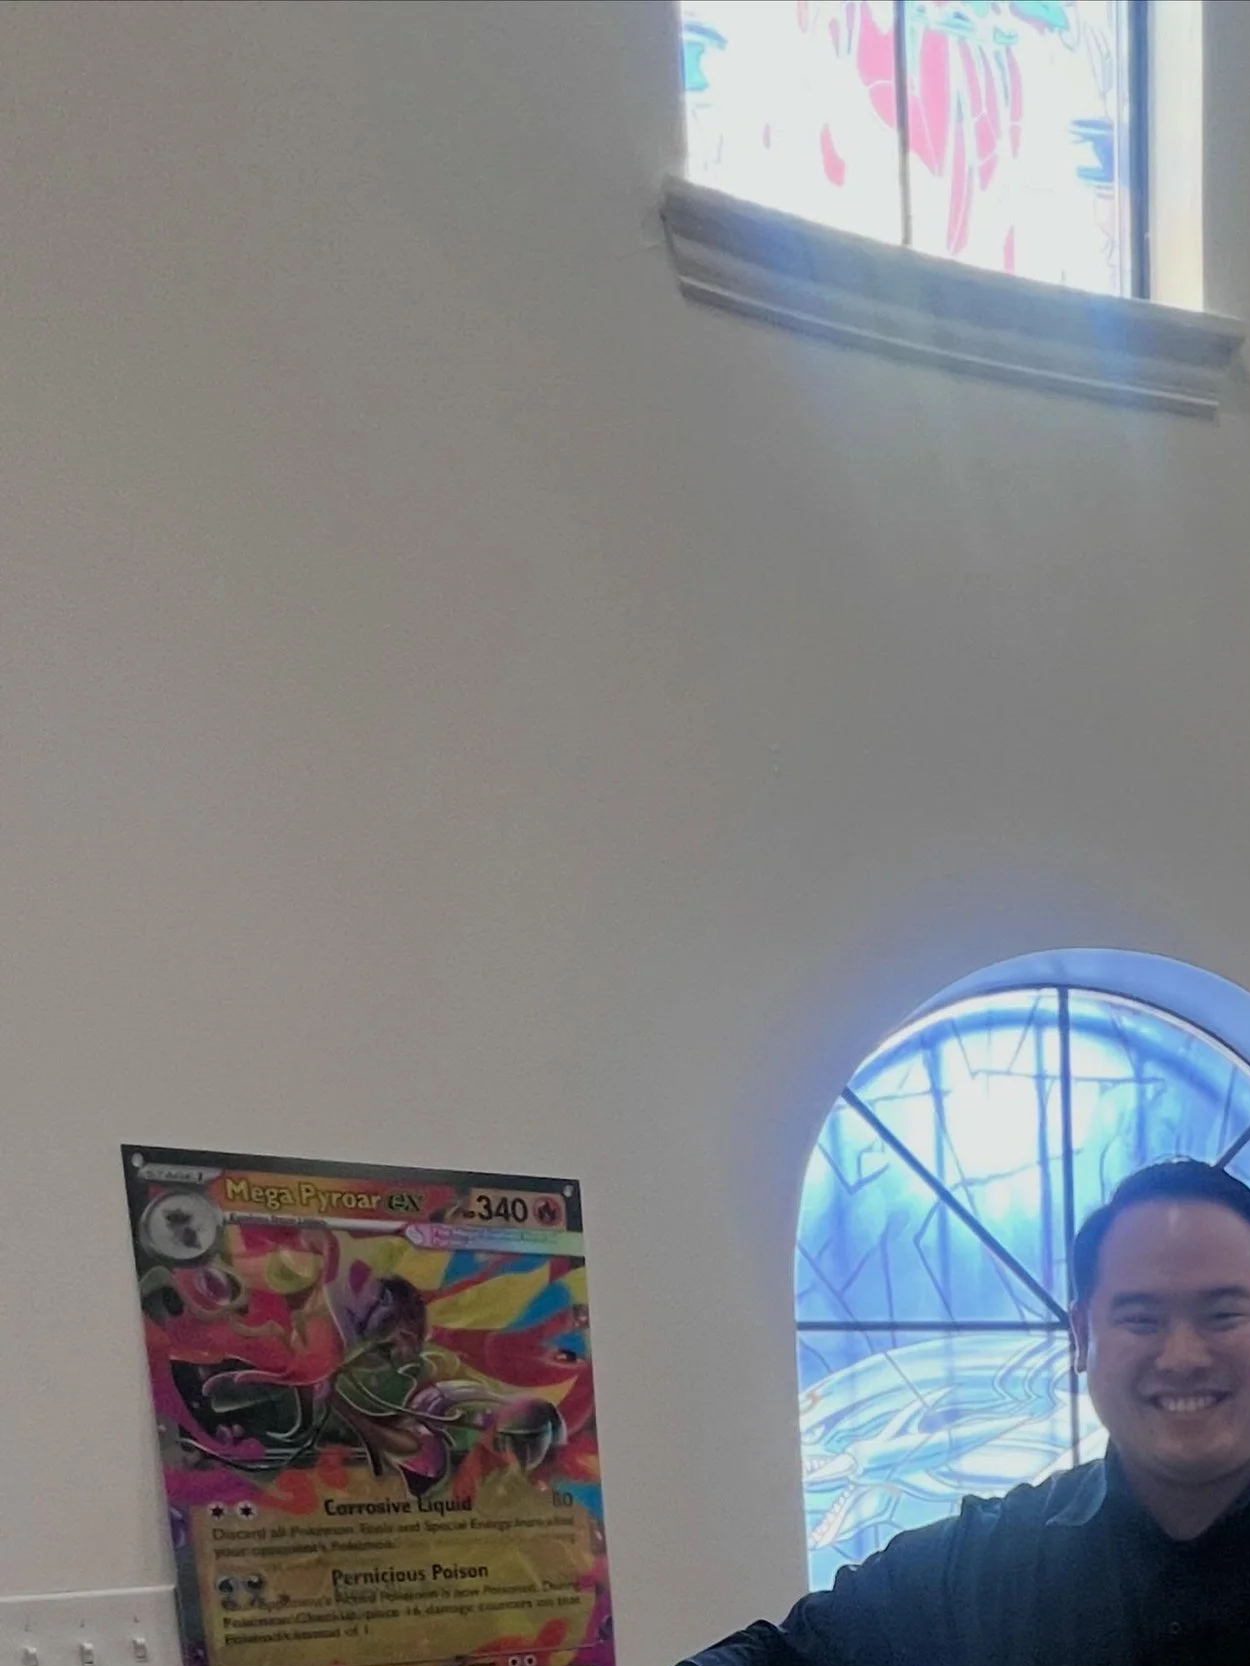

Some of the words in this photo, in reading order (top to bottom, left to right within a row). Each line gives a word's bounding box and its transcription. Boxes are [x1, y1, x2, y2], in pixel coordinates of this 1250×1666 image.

[225, 1178, 294, 1211] Mega
[299, 1182, 381, 1213] Pyroar
[387, 1193, 426, 1212] ex
[476, 1195, 529, 1223] 340
[324, 1499, 412, 1517] Corrosive
[417, 1495, 473, 1517] Liquid
[332, 1566, 427, 1587] Pernicious
[431, 1563, 489, 1580] Poison
